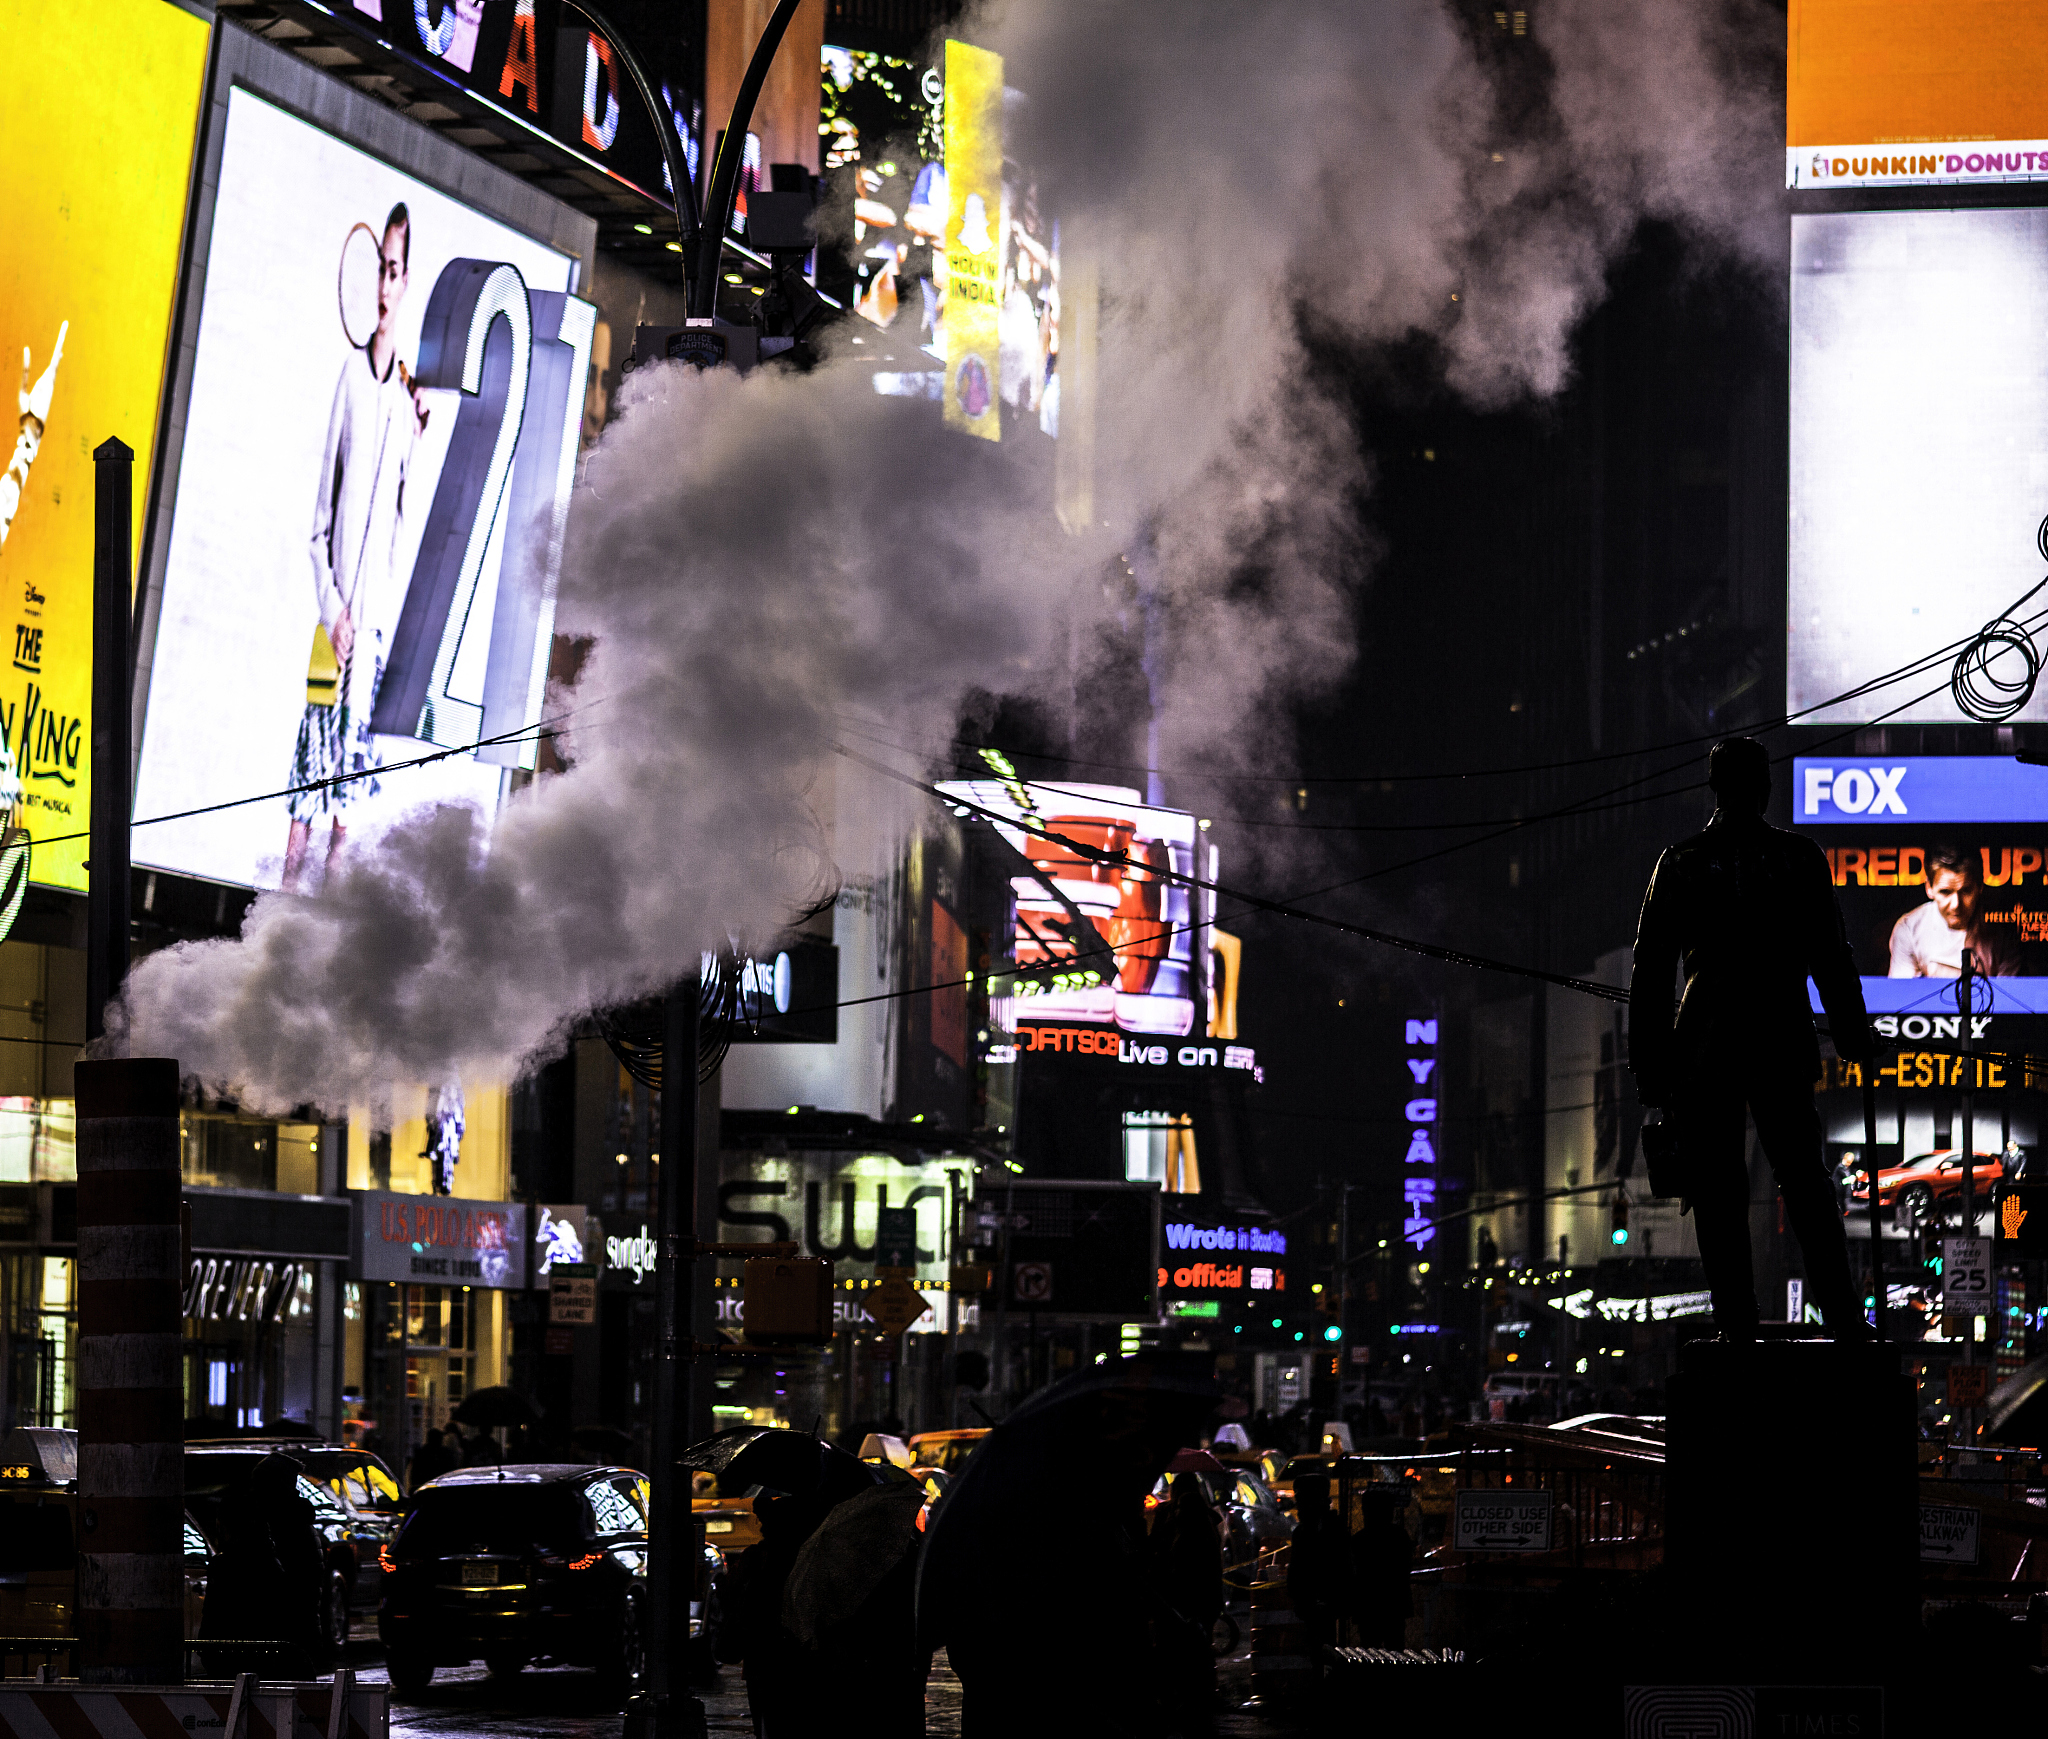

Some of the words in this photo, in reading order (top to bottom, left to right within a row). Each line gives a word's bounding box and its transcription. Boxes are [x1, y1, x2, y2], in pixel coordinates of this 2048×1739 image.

[951, 277, 996, 307] INDIA
[669, 341, 724, 355] DEPARTMENT
[681, 333, 713, 343] POLICE
[15, 623, 43, 664] THE
[17, 682, 81, 779] KING
[1804, 766, 1908, 815] FOX
[43, 798, 72, 816] MUSICAL
[1873, 1015, 1993, 1040] SONY
[1118, 1039, 1169, 1065] Live
[1177, 1046, 1218, 1067] on
[381, 1202, 412, 1243] U.S.
[415, 1205, 461, 1246] POLO
[1165, 1223, 1237, 1250] Wrote
[1951, 1249, 1982, 1258] SPEED
[1954, 1259, 1978, 1267] LIMIT
[410, 1257, 447, 1276] SINCE
[1173, 1262, 1244, 1288] official
[1949, 1269, 1987, 1292] 25
[558, 1308, 584, 1320] LANE
[0, 1466, 30, 1479] 9C85
[1461, 1507, 1514, 1520] CLOSED
[1518, 1507, 1547, 1520] USE
[1462, 1521, 1508, 1535] OTHER
[1511, 1521, 1543, 1534] SIDE
[1776, 1713, 1862, 1736] TIMES
